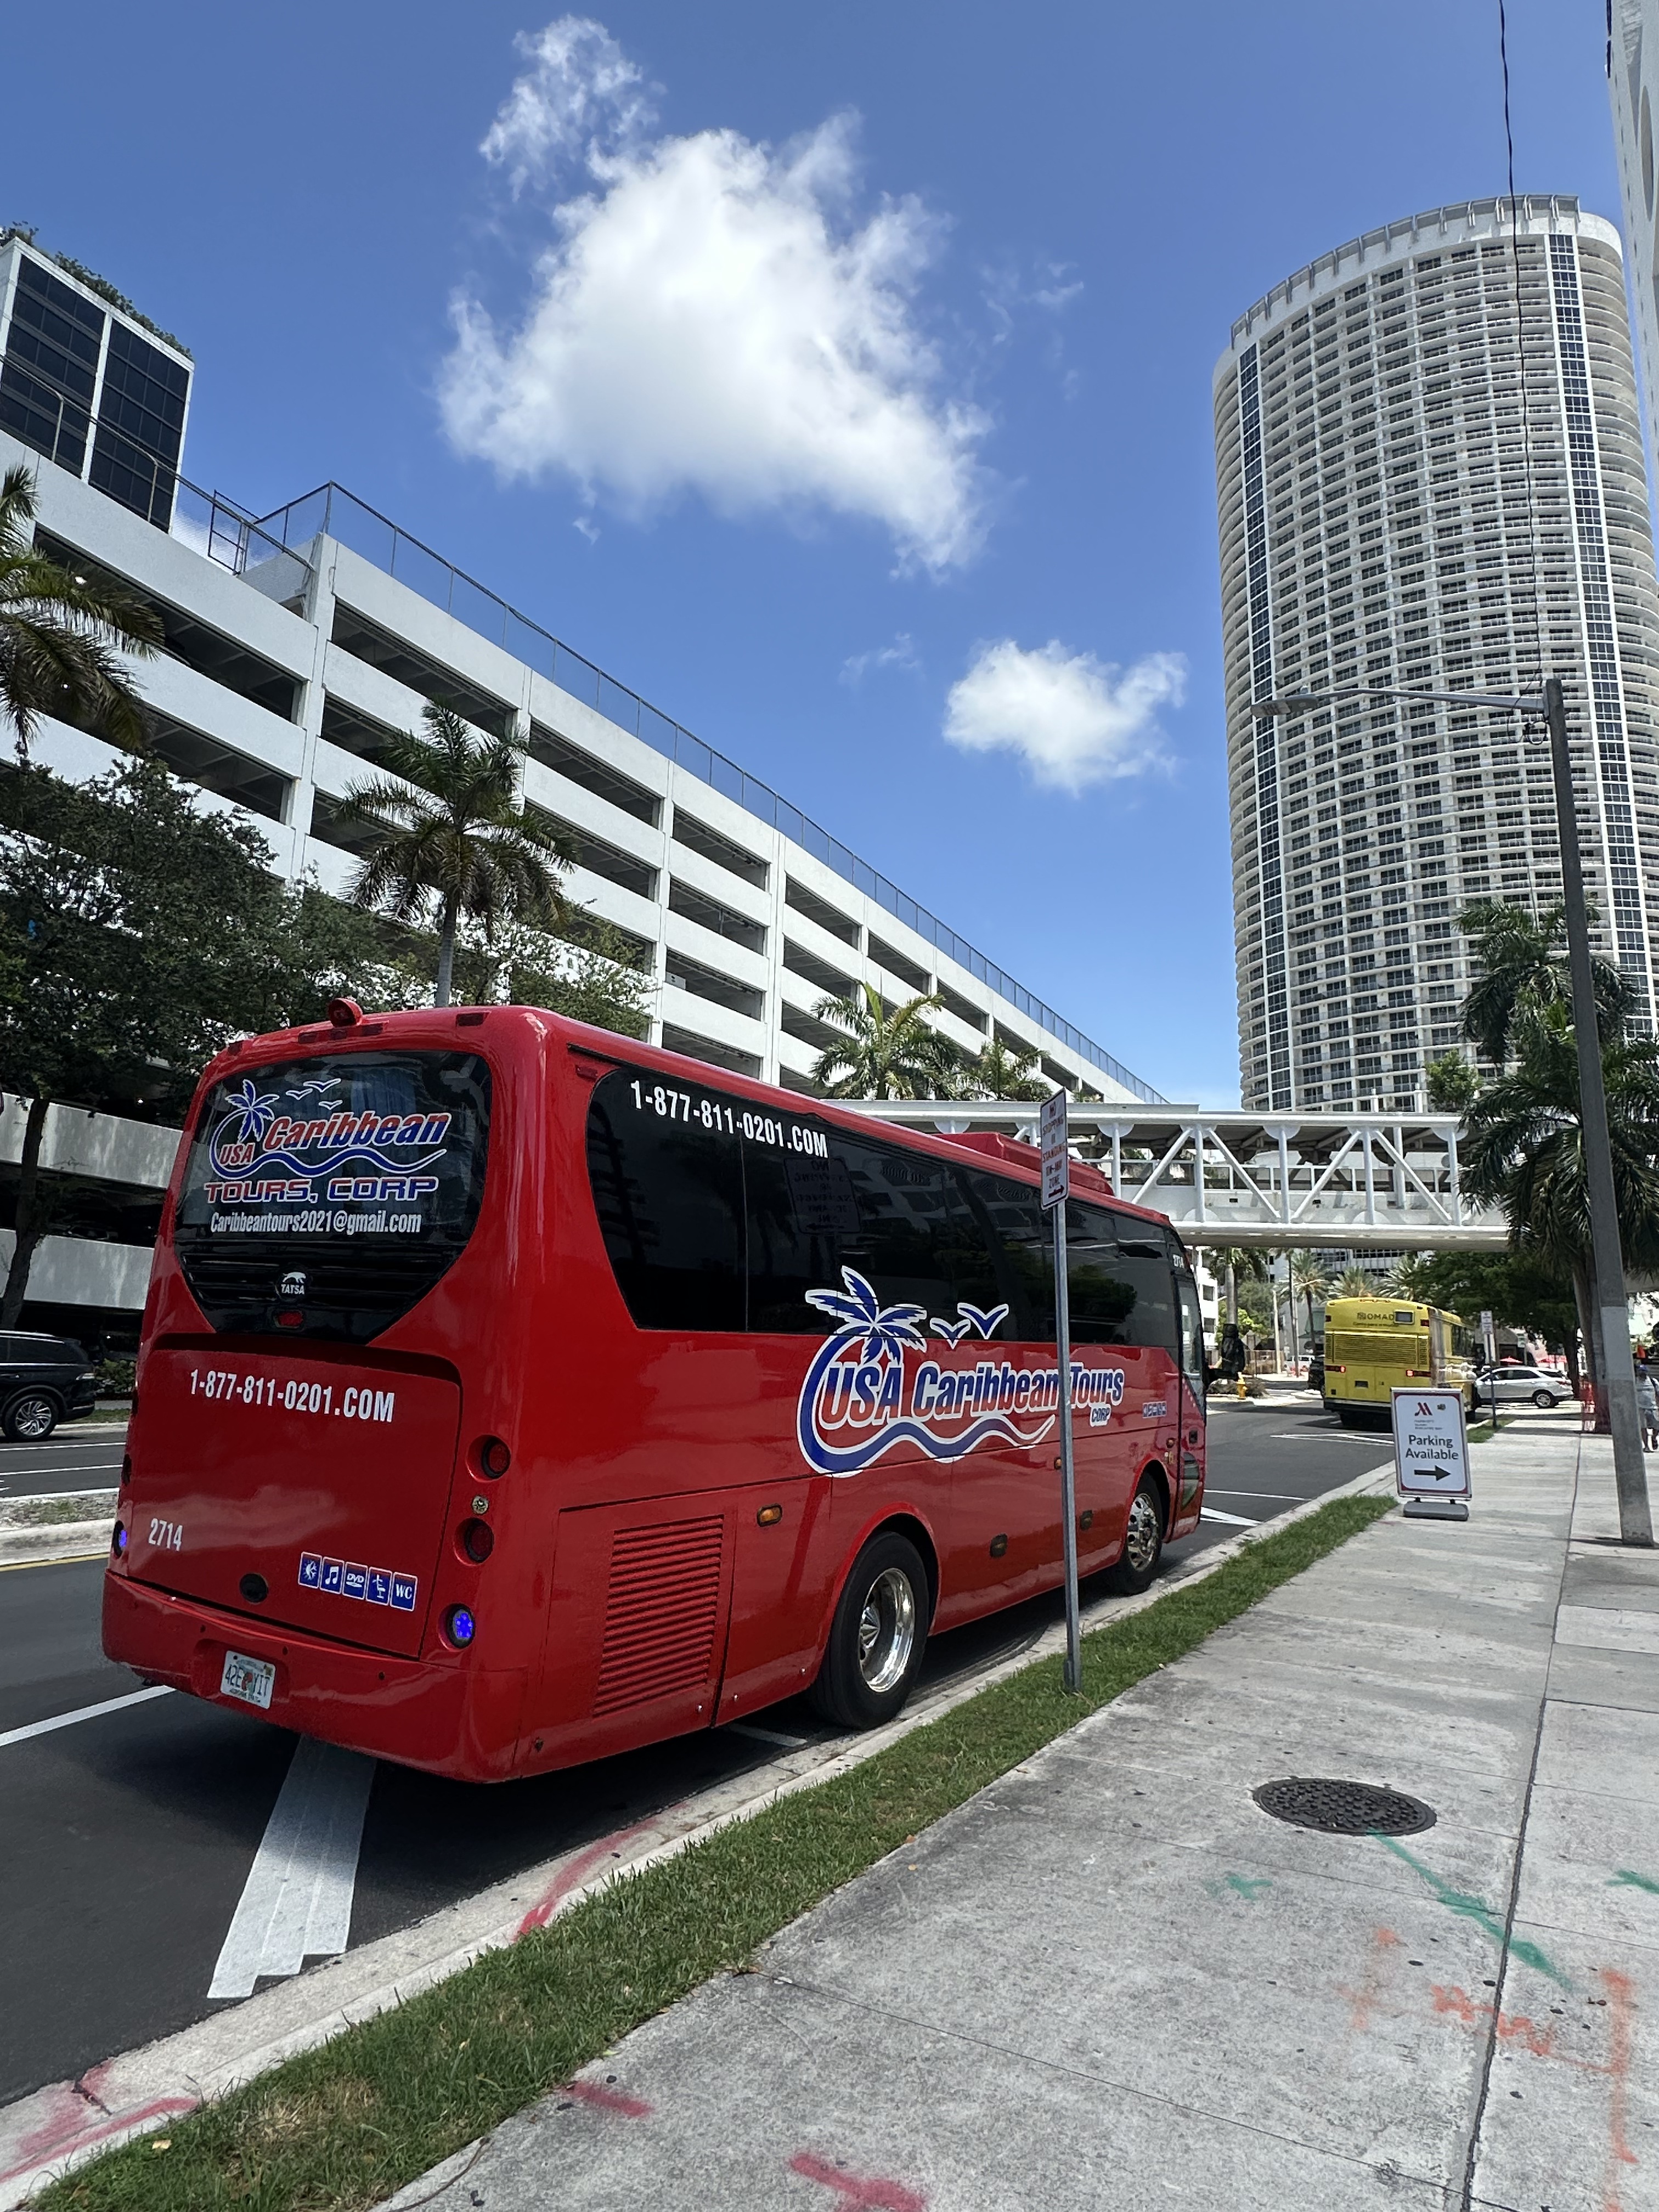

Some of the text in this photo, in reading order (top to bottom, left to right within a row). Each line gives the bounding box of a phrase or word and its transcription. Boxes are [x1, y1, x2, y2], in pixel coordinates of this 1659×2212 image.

[263, 1111, 451, 1152] Caribbean
[631, 1080, 828, 1159] 1-877-811-0201.COM
[220, 1143, 255, 1166] USA
[204, 1176, 439, 1203] TOURS, CORP
[211, 1210, 422, 1235] Caribbeantours2021@gmail.com
[281, 1284, 305, 1295] TATSA
[191, 1369, 394, 1423] 1-877-811-0201.COM
[819, 1362, 1125, 1429] USA Caribbean Tours
[1406, 1447, 1459, 1460] Available
[1408, 1434, 1453, 1448] Parking
[148, 1517, 183, 1551] 2714
[346, 1573, 364, 1583] DVD
[396, 1583, 413, 1599] WC
